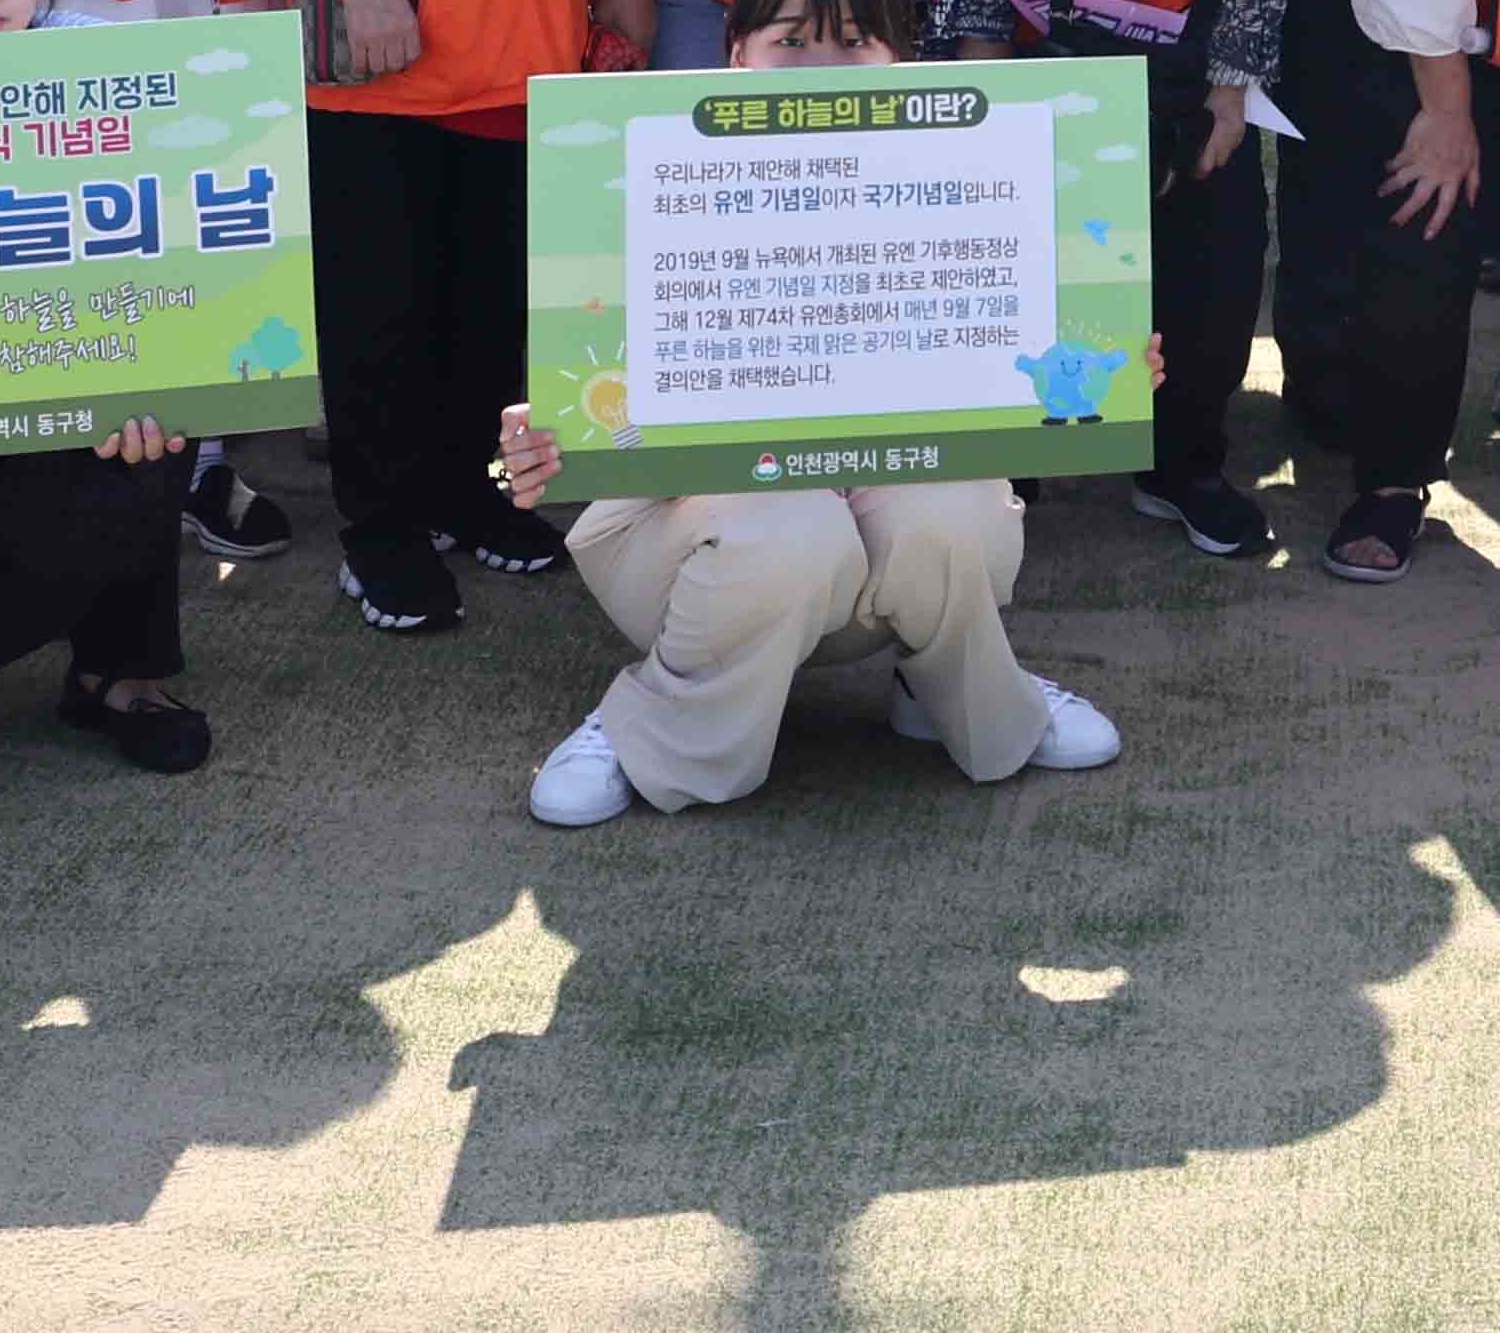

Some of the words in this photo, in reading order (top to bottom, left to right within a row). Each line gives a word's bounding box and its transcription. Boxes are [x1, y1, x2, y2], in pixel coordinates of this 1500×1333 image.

[76, 71, 178, 115] 지정된
[777, 96, 861, 128] 하늘의
[23, 115, 132, 161] 기념일
[653, 161, 743, 185] 우리나라가
[748, 159, 801, 181] 제안해
[806, 156, 859, 179] 채택된
[189, 163, 280, 254] 날
[653, 193, 707, 216] 최초의
[713, 190, 754, 215] 유엔
[760, 186, 857, 213] 기념일이자
[862, 179, 1019, 208] 국가기념일입니다.
[653, 250, 717, 273] 2019년
[721, 248, 750, 270] 9월
[755, 245, 823, 268] 뉴욕에서
[827, 243, 877, 265] 개최된
[882, 241, 916, 263] 유엔
[920, 236, 1019, 262] 기후행동정상
[89, 280, 196, 327] 만들기에
[654, 369, 724, 394] 결의안을
[728, 364, 836, 390] 채택했습니다.
[36, 409, 94, 437] 동구청
[785, 448, 877, 477] 인천광역시
[884, 445, 939, 472] 동구청
